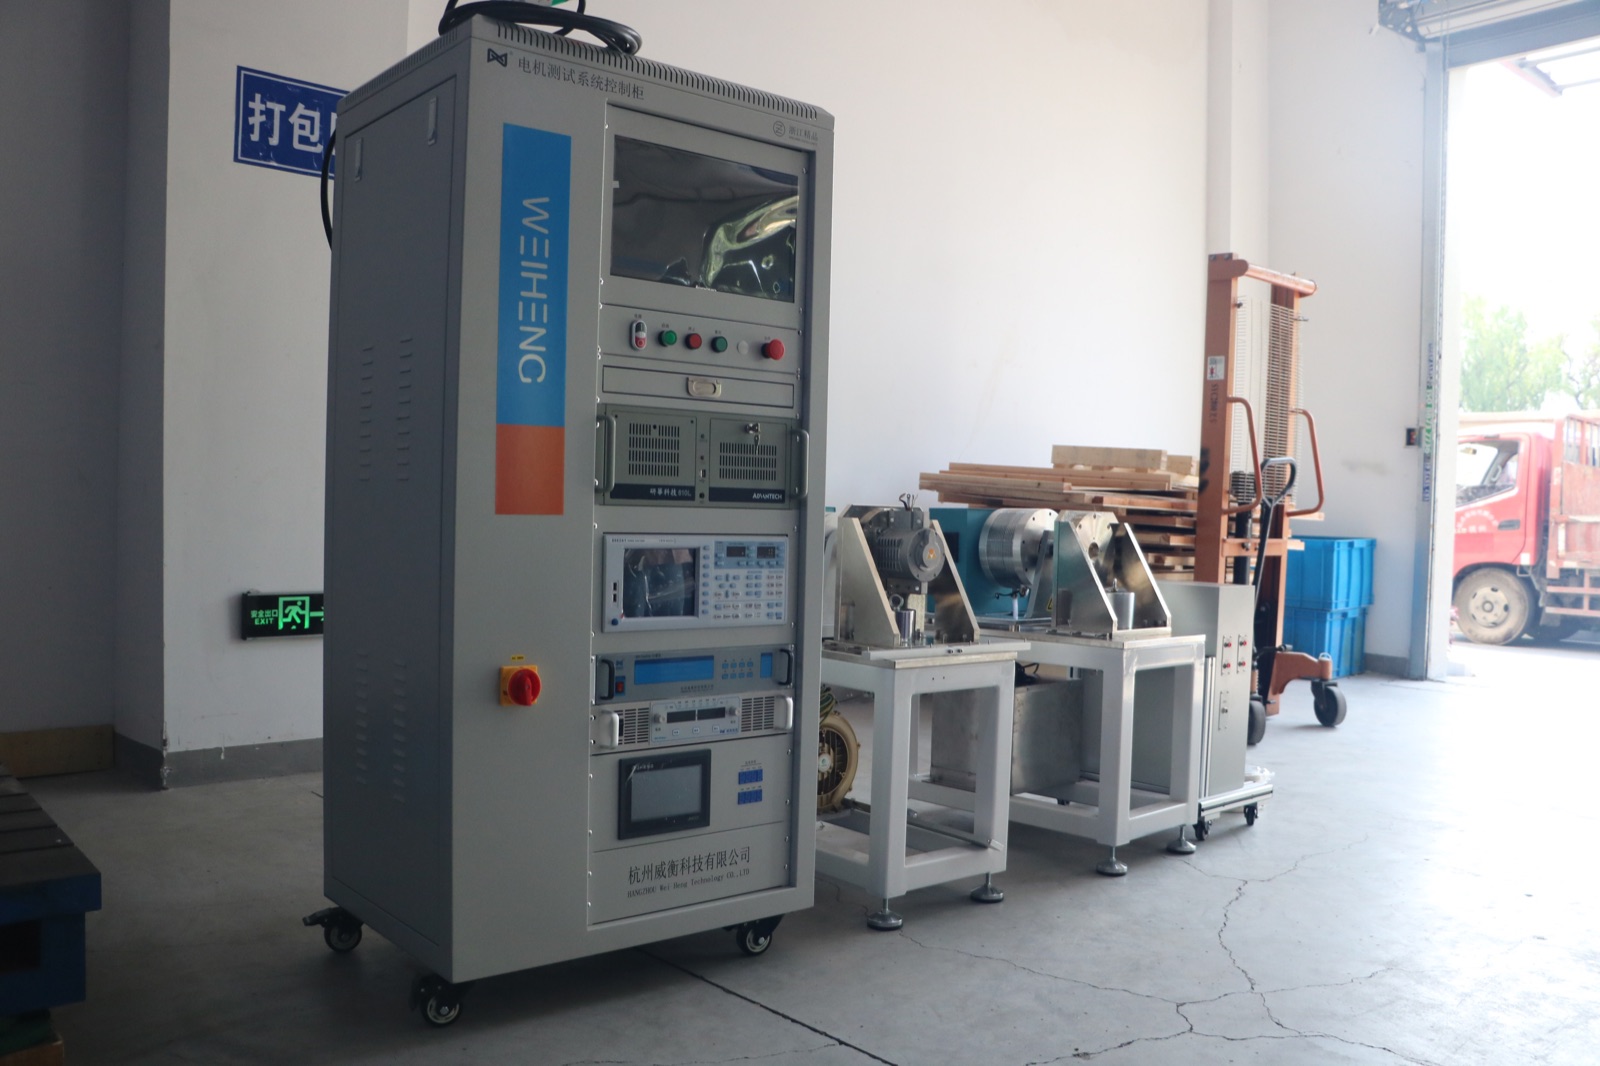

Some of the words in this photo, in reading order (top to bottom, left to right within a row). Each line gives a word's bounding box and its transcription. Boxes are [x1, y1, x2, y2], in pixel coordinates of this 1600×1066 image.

[518, 56, 645, 100] 电机测试系统控制柜
[248, 92, 337, 155] 打包
[518, 197, 550, 383] WEIHENG
[752, 492, 783, 500] ADVANTECH
[251, 609, 278, 618] 安全出口
[628, 846, 750, 885] 杭州威衡科技有限公司
[627, 888, 657, 898] HANGZHOU
[660, 883, 670, 892] Wei
[673, 880, 688, 890] Heng
[691, 874, 724, 886] Technology
